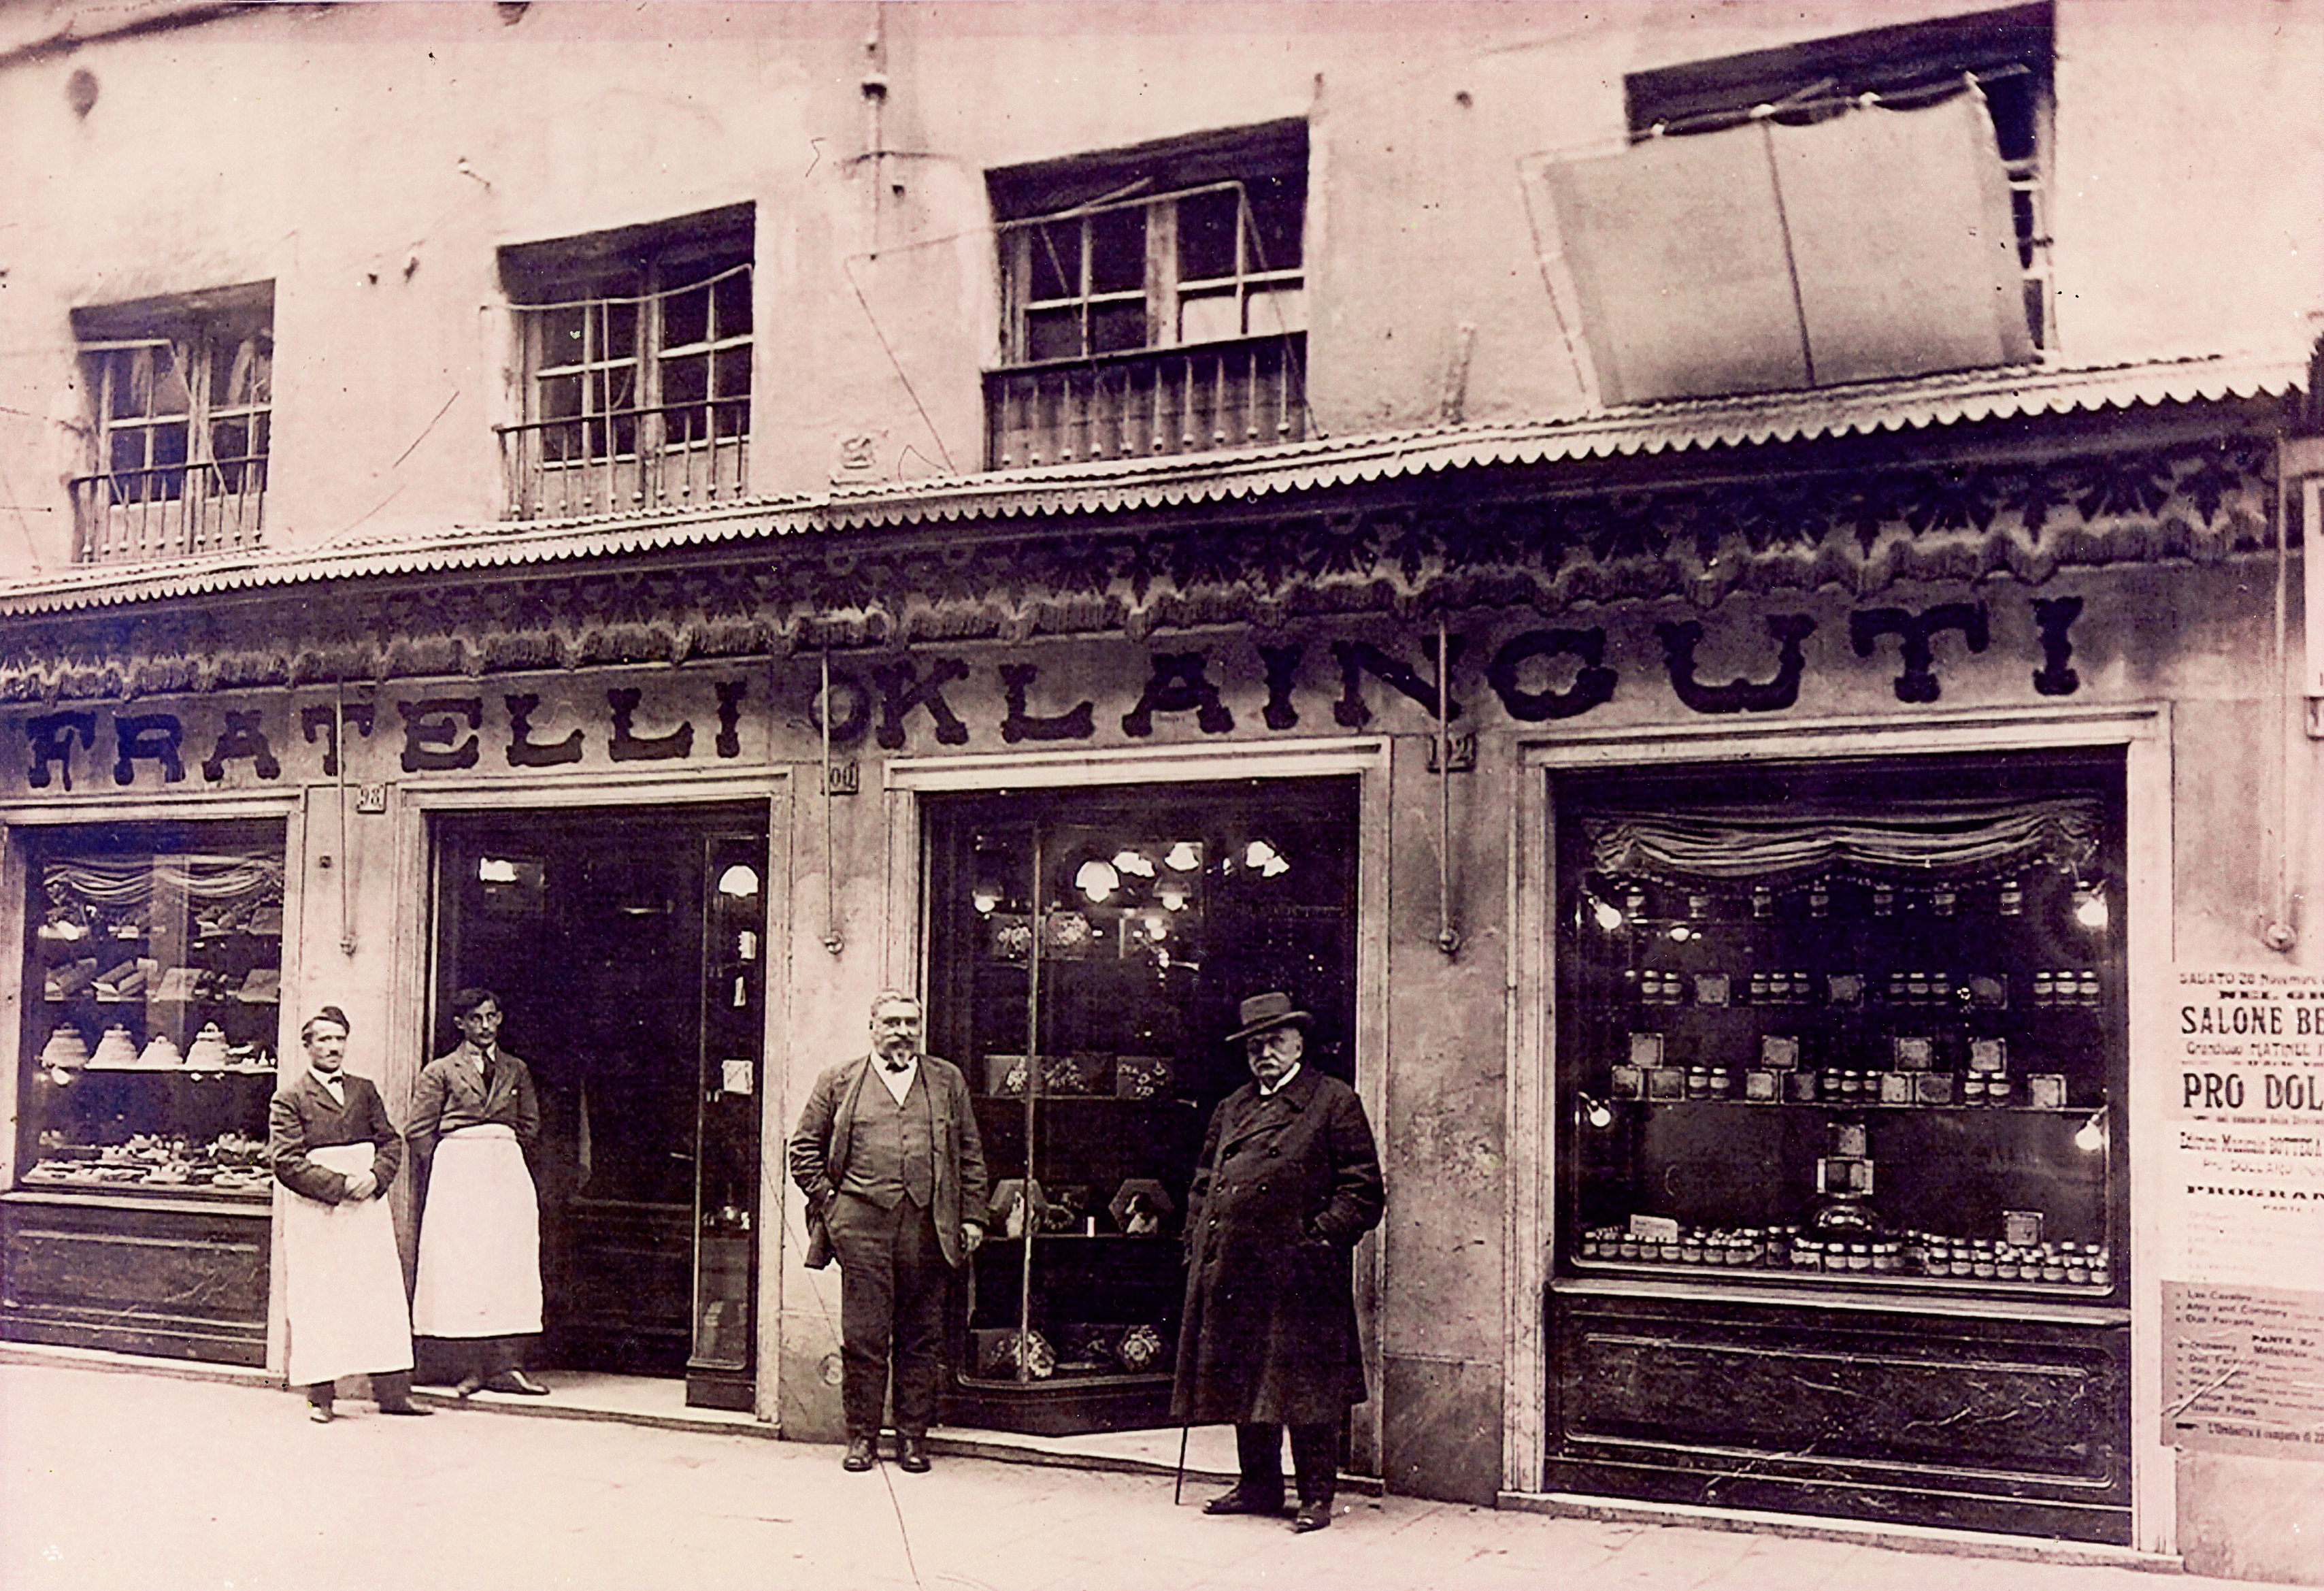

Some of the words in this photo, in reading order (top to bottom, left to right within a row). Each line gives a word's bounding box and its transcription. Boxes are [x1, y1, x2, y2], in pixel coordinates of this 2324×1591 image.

[25, 680, 747, 791] FRATELLI
[2181, 1006, 2282, 1034] SALONE
[2183, 1073, 2244, 1109] PRO
[2265, 1075, 2324, 1110] DOL
